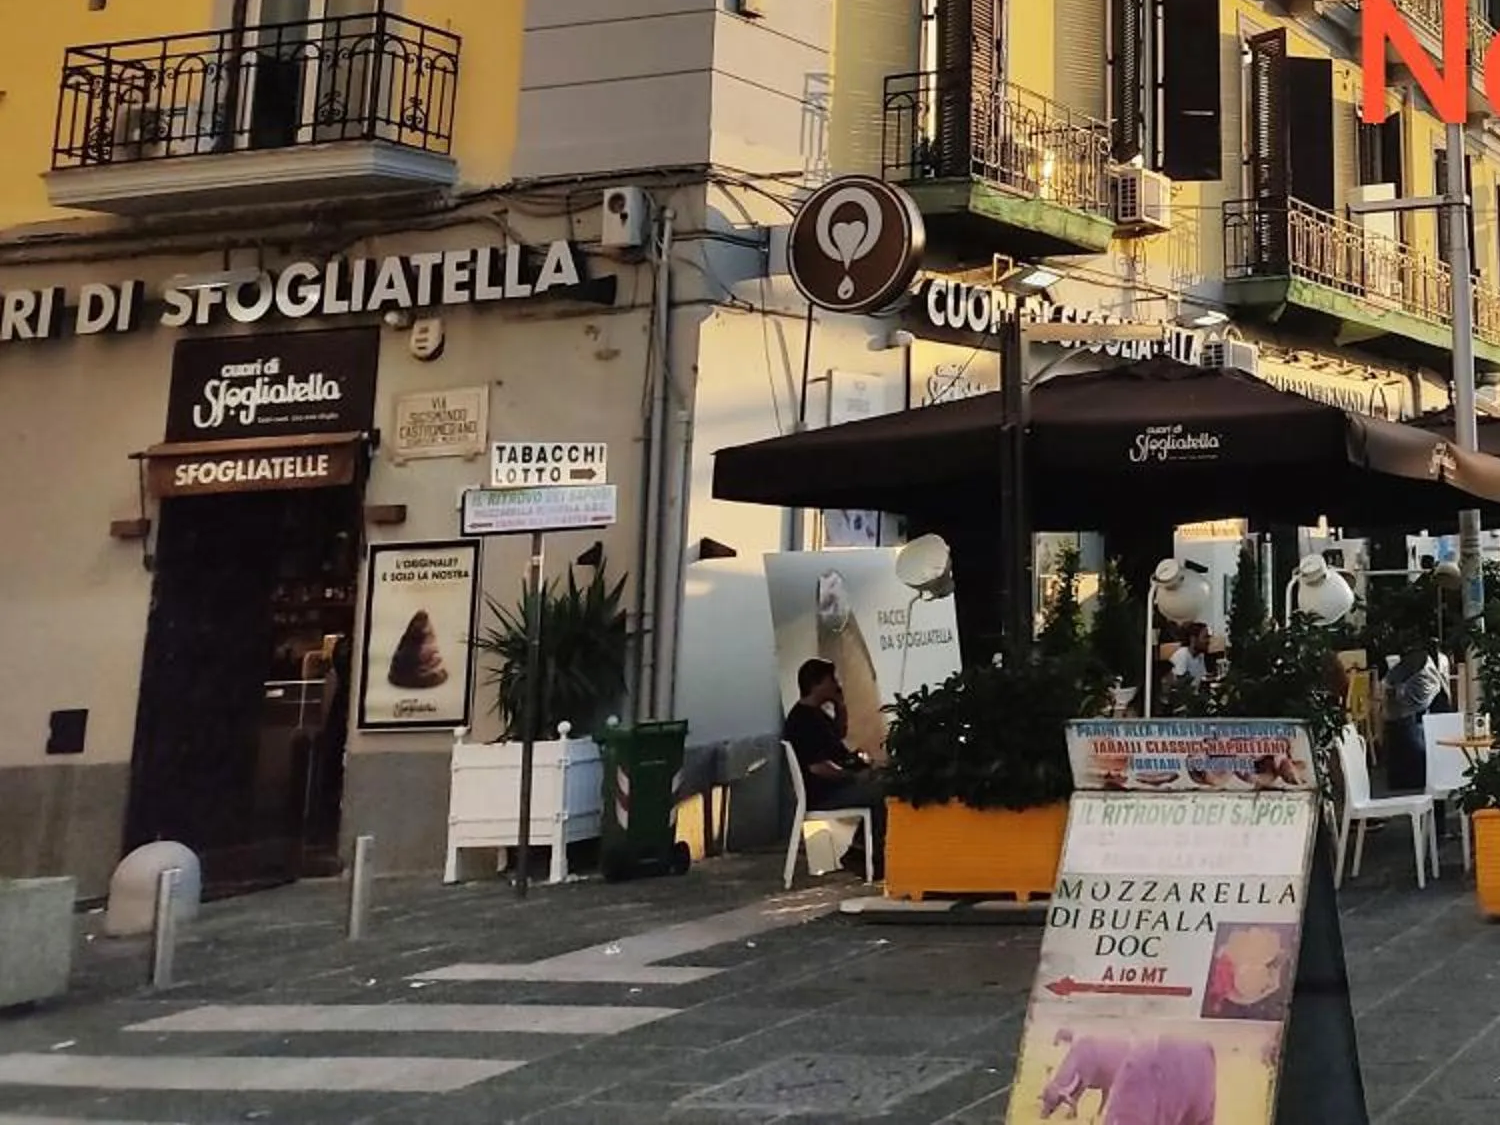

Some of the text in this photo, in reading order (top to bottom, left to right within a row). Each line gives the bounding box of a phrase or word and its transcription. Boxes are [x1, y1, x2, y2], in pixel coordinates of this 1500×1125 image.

[76, 279, 137, 335] DI
[160, 239, 580, 328] SFOGLIATELLA
[193, 373, 343, 428] Sfogliatella
[496, 445, 604, 464] TABACCHI
[175, 455, 329, 486] SFOGLIATELLE
[496, 467, 561, 483] LOTTO
[1102, 803, 1188, 826] RITROVO
[1193, 804, 1226, 826] DEI
[1058, 879, 1296, 905] MOZZARELLA
[1050, 906, 1215, 932] DI BUFALA
[1095, 935, 1162, 958] DOC
[1103, 967, 1114, 982] A
[1141, 966, 1168, 984] MT
